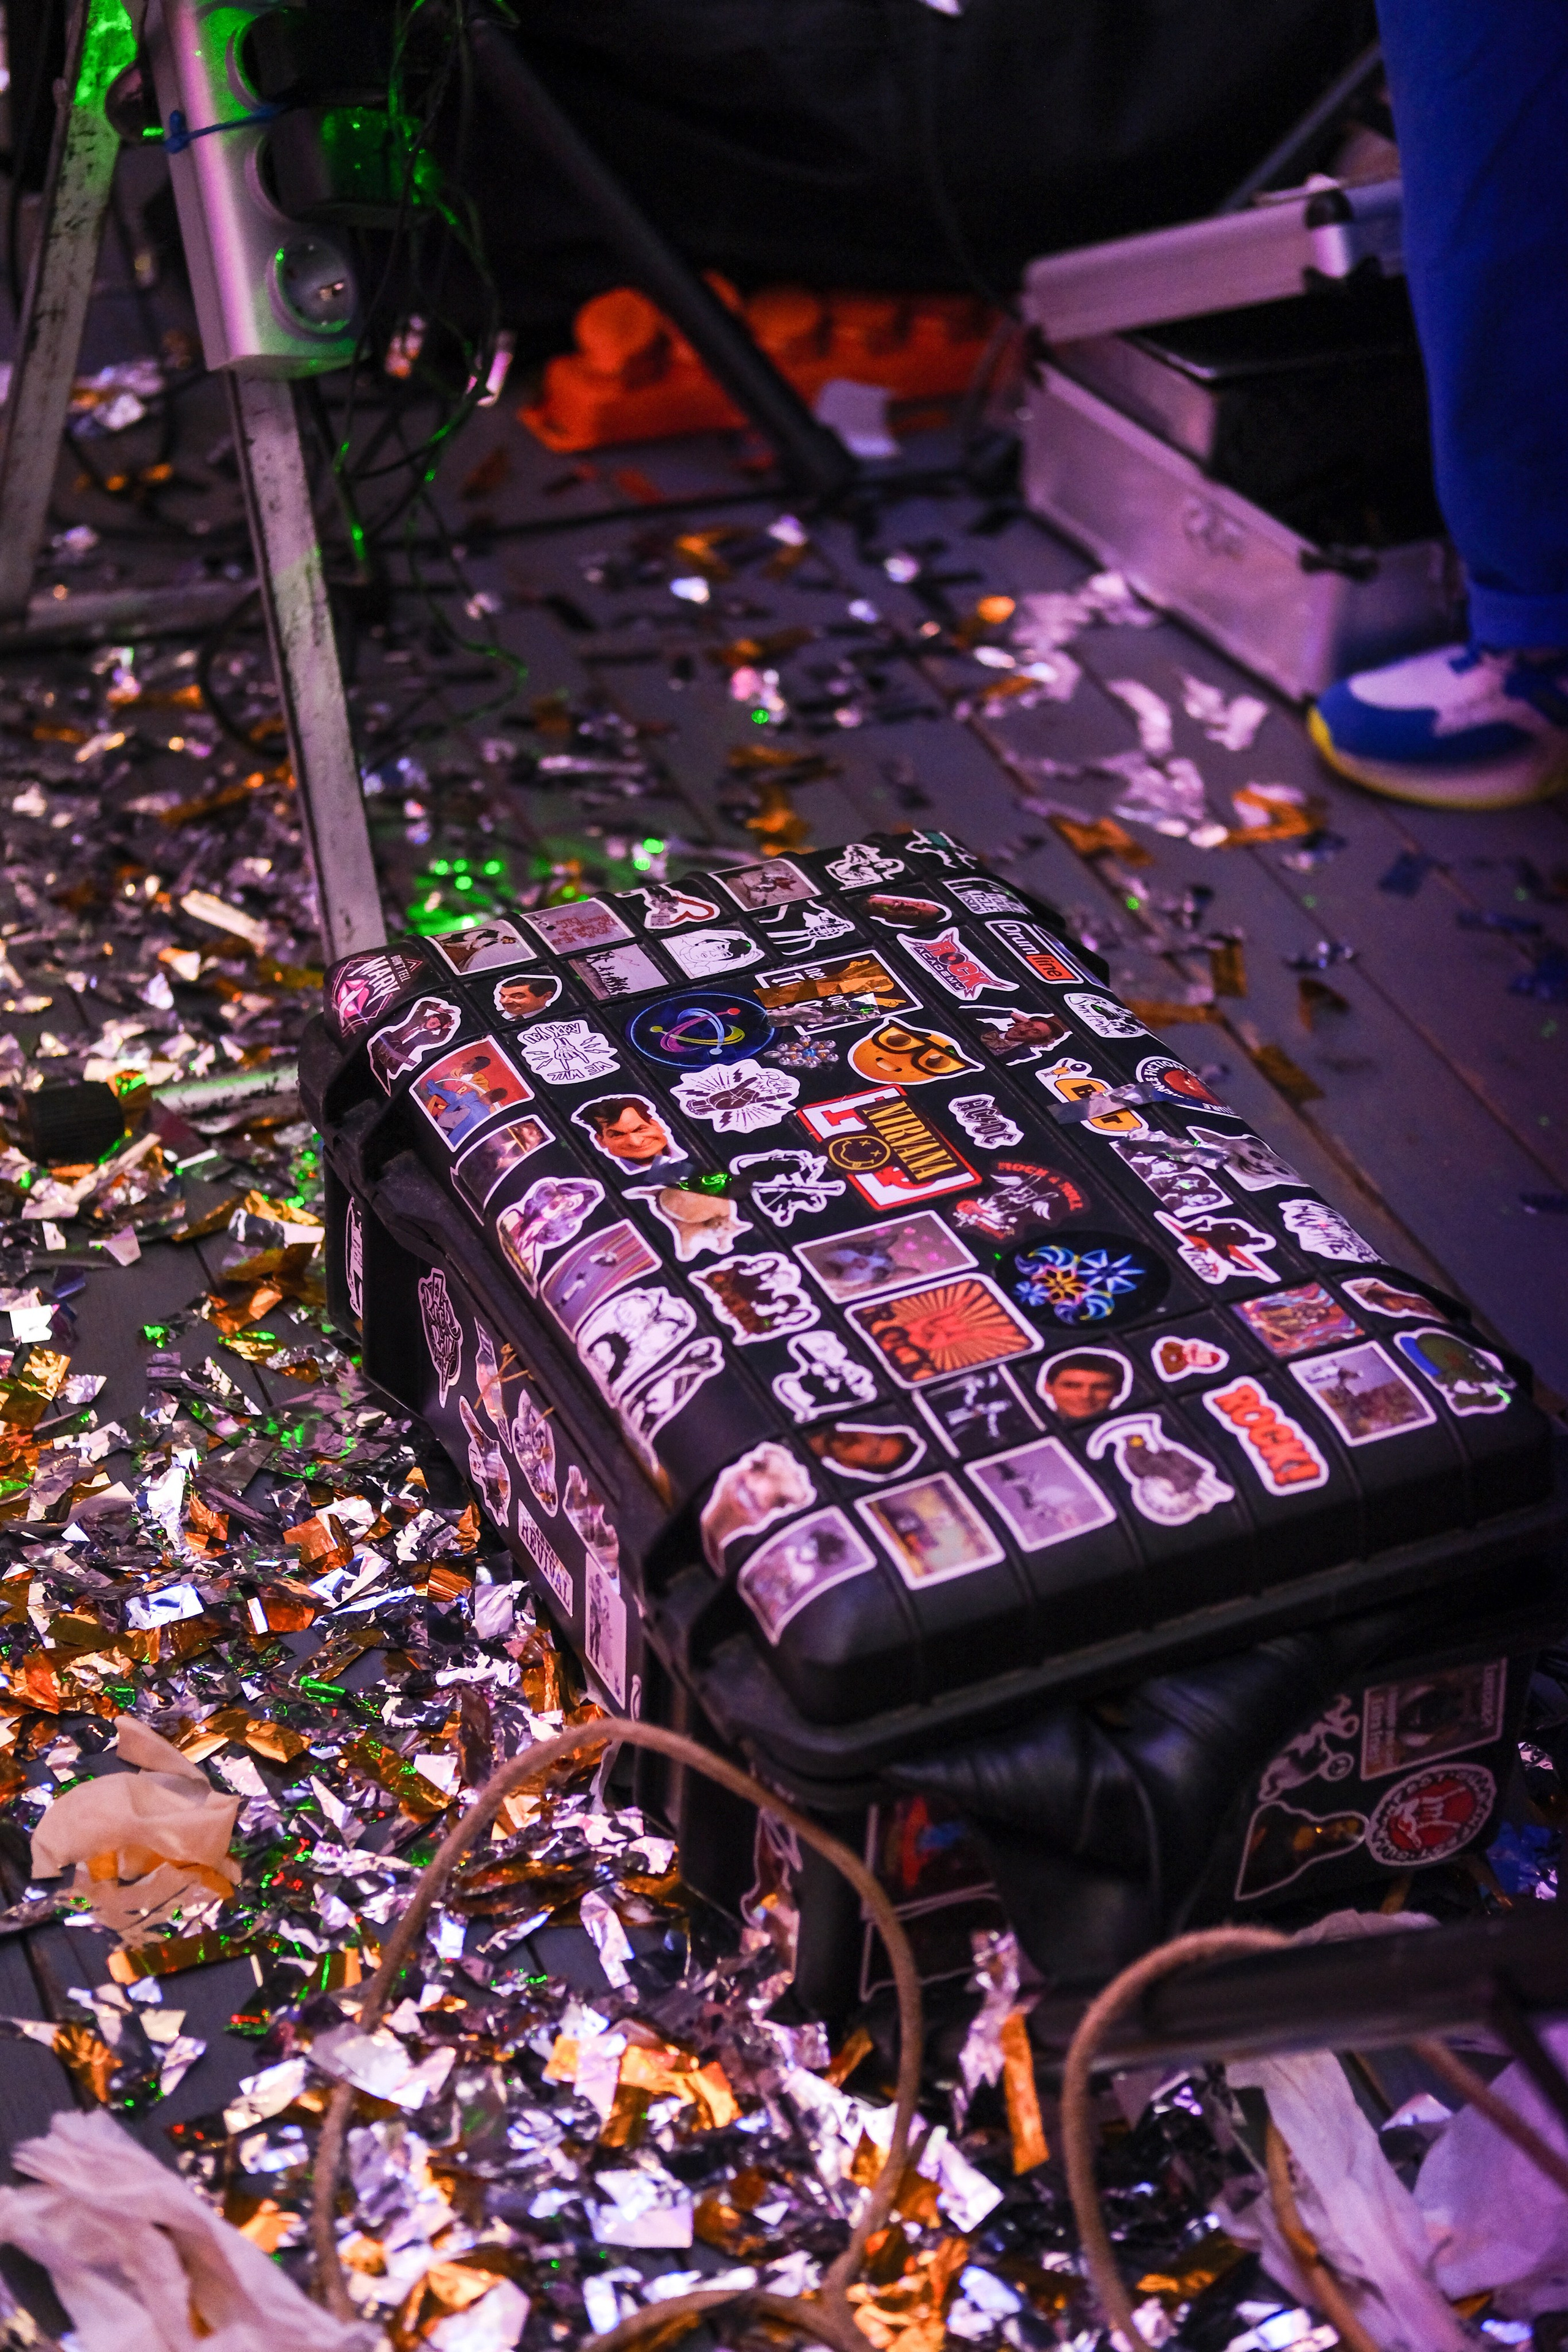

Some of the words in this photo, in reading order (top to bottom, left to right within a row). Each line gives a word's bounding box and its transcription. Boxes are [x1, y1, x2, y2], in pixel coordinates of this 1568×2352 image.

[347, 955, 401, 1008] MARY
[397, 968, 411, 982] TELL
[914, 946, 965, 990] ACADEMY
[925, 938, 995, 991] ROCK
[523, 1027, 551, 1044] YOU
[547, 1069, 586, 1081] WILL
[584, 1061, 613, 1076] WE
[1144, 1060, 1185, 1077] FICTION
[862, 1101, 958, 1180] NIRVANA
[1212, 1384, 1321, 1487] ROCK!
[521, 1520, 571, 1609] REVIVAL
